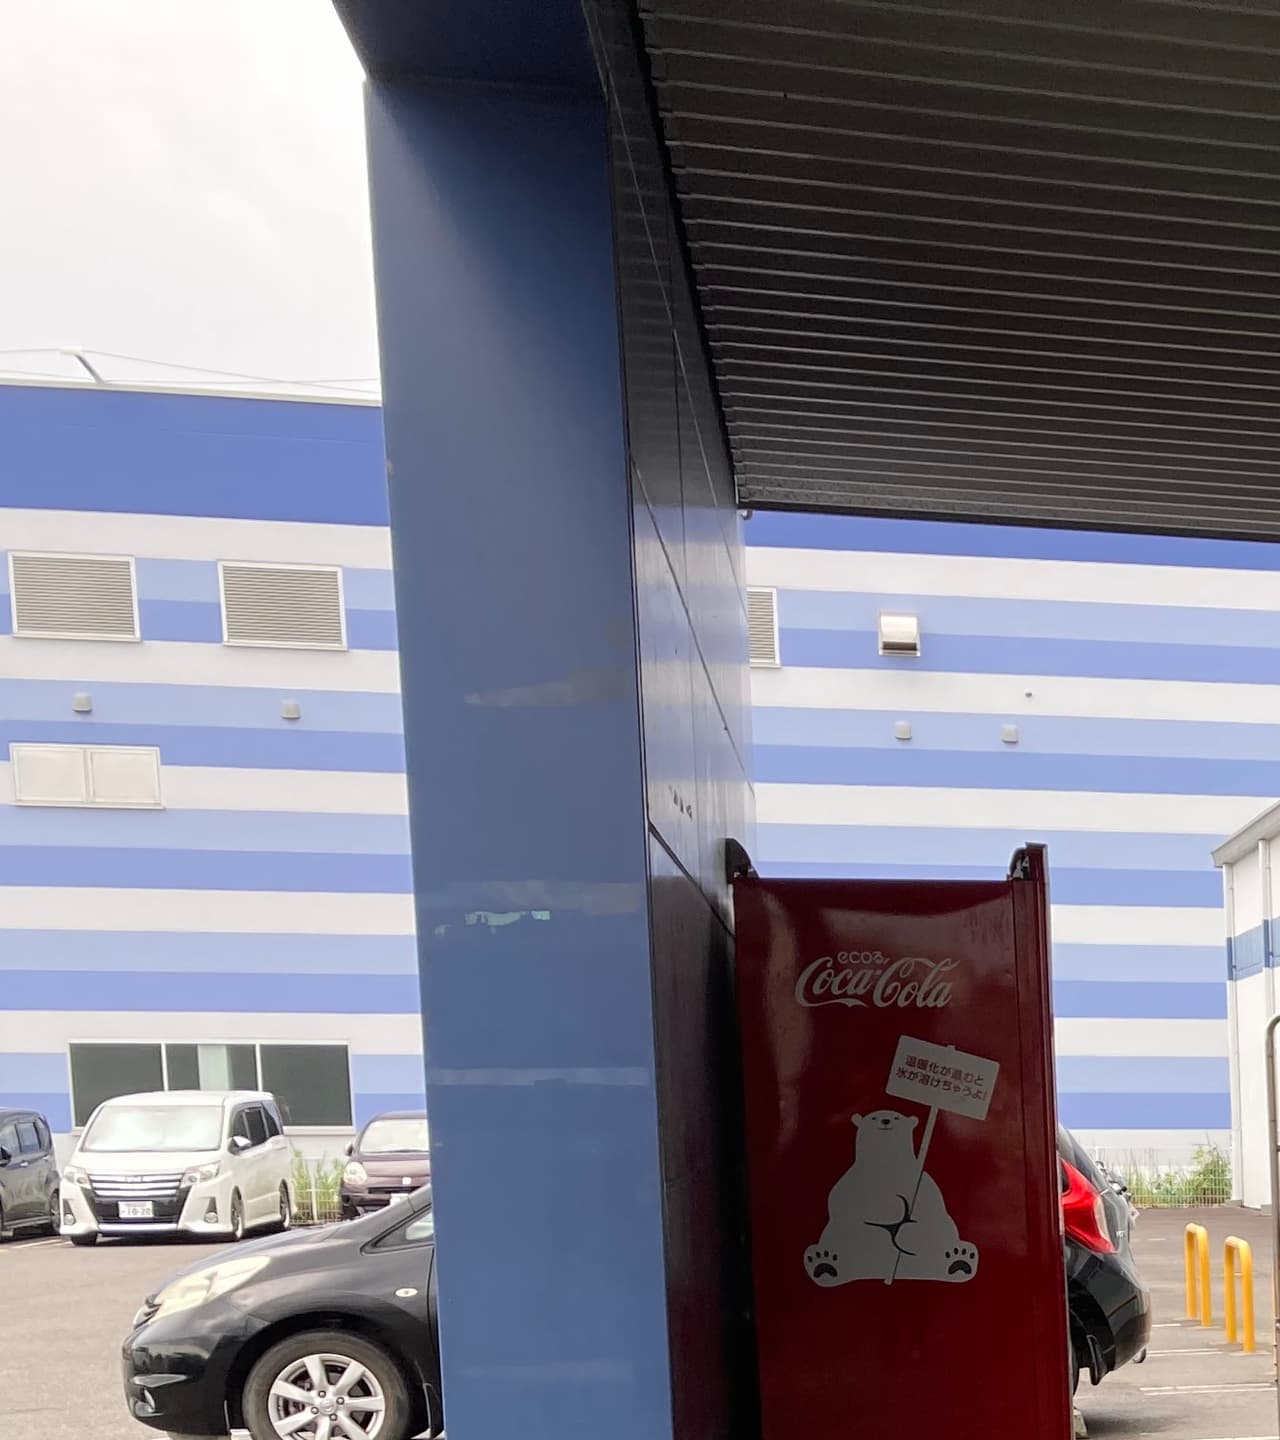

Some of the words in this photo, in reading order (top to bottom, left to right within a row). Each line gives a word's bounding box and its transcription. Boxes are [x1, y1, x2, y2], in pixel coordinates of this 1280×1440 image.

[795, 957, 961, 1008] Coca-Cola
[905, 1055, 985, 1087] 温暖化が進むと
